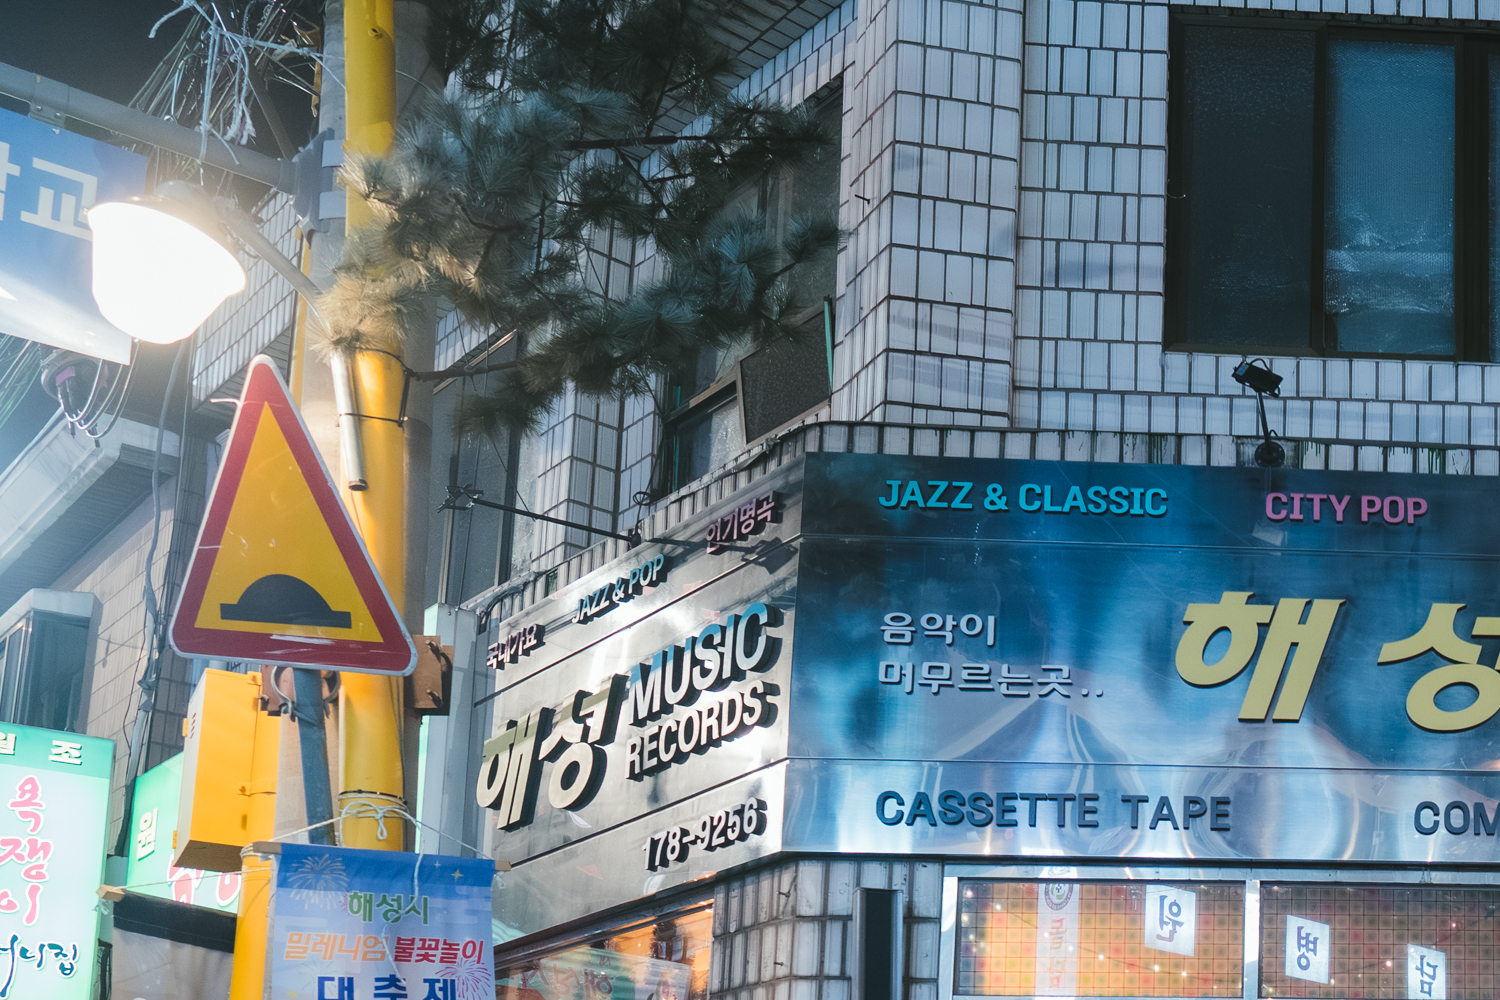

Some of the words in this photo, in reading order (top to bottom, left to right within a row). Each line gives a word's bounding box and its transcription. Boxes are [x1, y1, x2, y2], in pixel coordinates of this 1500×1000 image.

[0, 141, 98, 241] 교
[704, 490, 776, 555] 인기명곡
[878, 480, 974, 510] JAZZ
[983, 483, 1009, 511] &
[1018, 484, 1168, 517] CLASSIC
[1264, 492, 1350, 523] CITY
[1361, 496, 1428, 525] POP
[571, 587, 614, 625] JAZZ
[610, 576, 627, 603] &
[628, 553, 667, 597] POP
[486, 623, 543, 671] 국내가요
[880, 611, 996, 647] 음악이
[628, 602, 770, 727] MUSIC
[476, 672, 629, 830] 해성
[625, 680, 768, 781] RECORDS
[641, 798, 759, 873] 178-9256
[875, 790, 1099, 829] CASSETTE
[1121, 795, 1232, 832] TAPE
[347, 890, 430, 926] 해성시
[283, 931, 388, 962] 밀레니엄
[392, 936, 485, 965] 불꽃놀이
